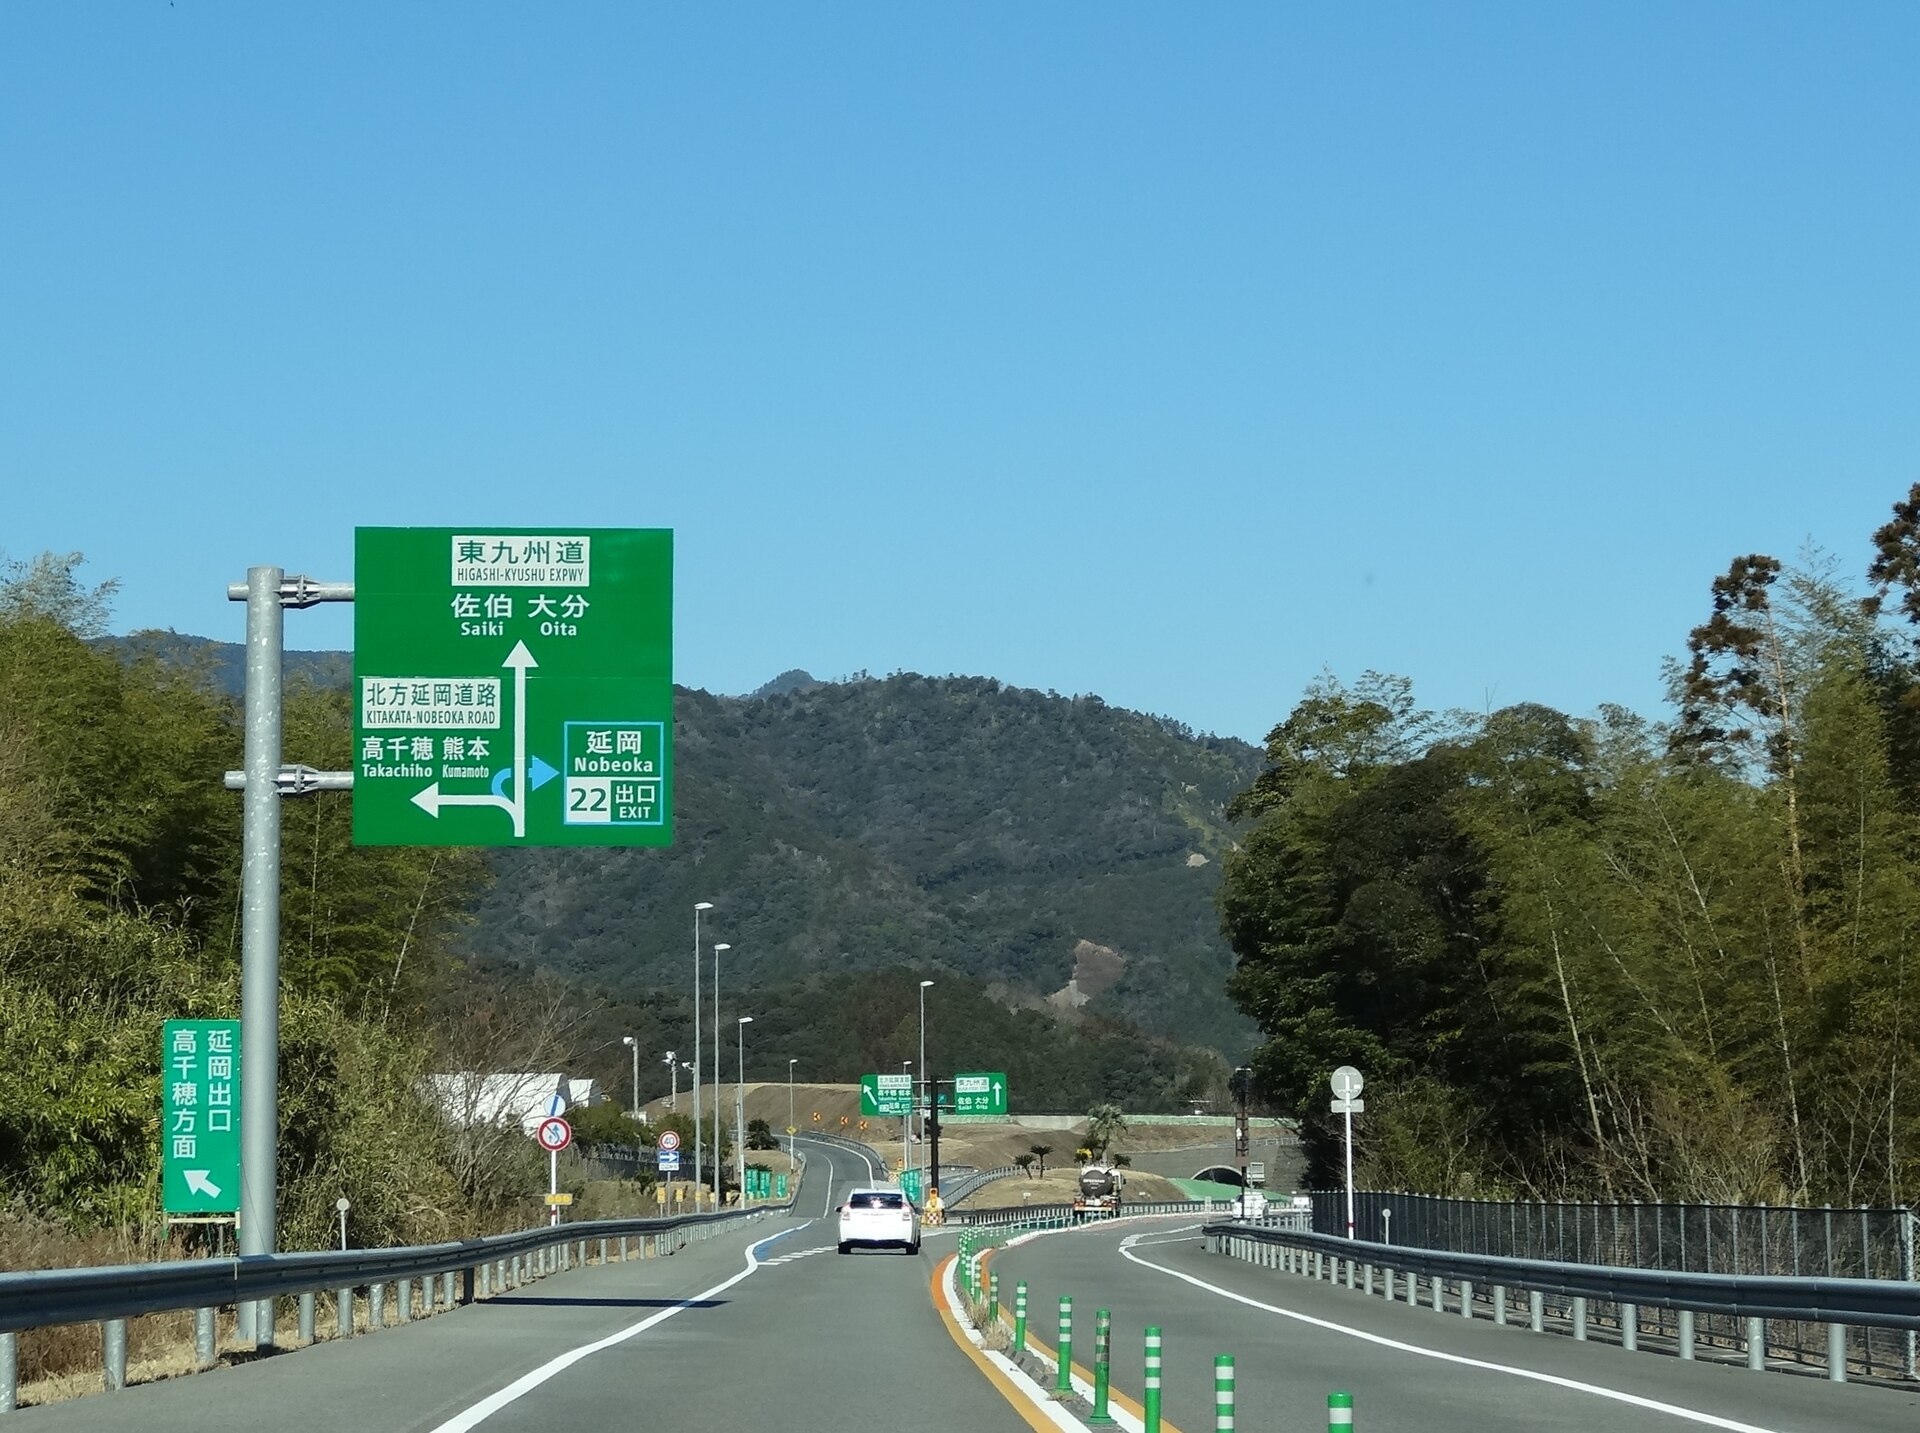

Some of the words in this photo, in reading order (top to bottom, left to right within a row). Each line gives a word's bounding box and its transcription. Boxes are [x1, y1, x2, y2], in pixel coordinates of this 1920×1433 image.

[458, 540, 584, 564] 東九州道
[458, 568, 545, 581] HIGASHI-KYUSHU
[550, 568, 583, 581] EXPWY
[451, 594, 511, 617] 佐伯
[528, 594, 589, 617] 大分
[462, 622, 503, 635] Saiki
[541, 622, 576, 635] Oita
[367, 683, 495, 707] 北方延岡道路
[367, 711, 464, 723] KITAKATA-NOBEOKA
[468, 711, 495, 724] ROAD
[363, 736, 433, 760] 高千穂
[443, 737, 489, 760] 熊本
[587, 731, 641, 754] 延岡
[362, 764, 432, 777] Takachiho
[443, 765, 489, 777] Kumamoto
[575, 757, 652, 772] Nobeoka
[571, 788, 607, 811] 22
[616, 784, 654, 803] 出口
[620, 807, 650, 818] EXIT
[208, 1030, 232, 1131] 延岡出口
[173, 1029, 197, 1158] 高千穂方面
[664, 1137, 674, 1145] 40
